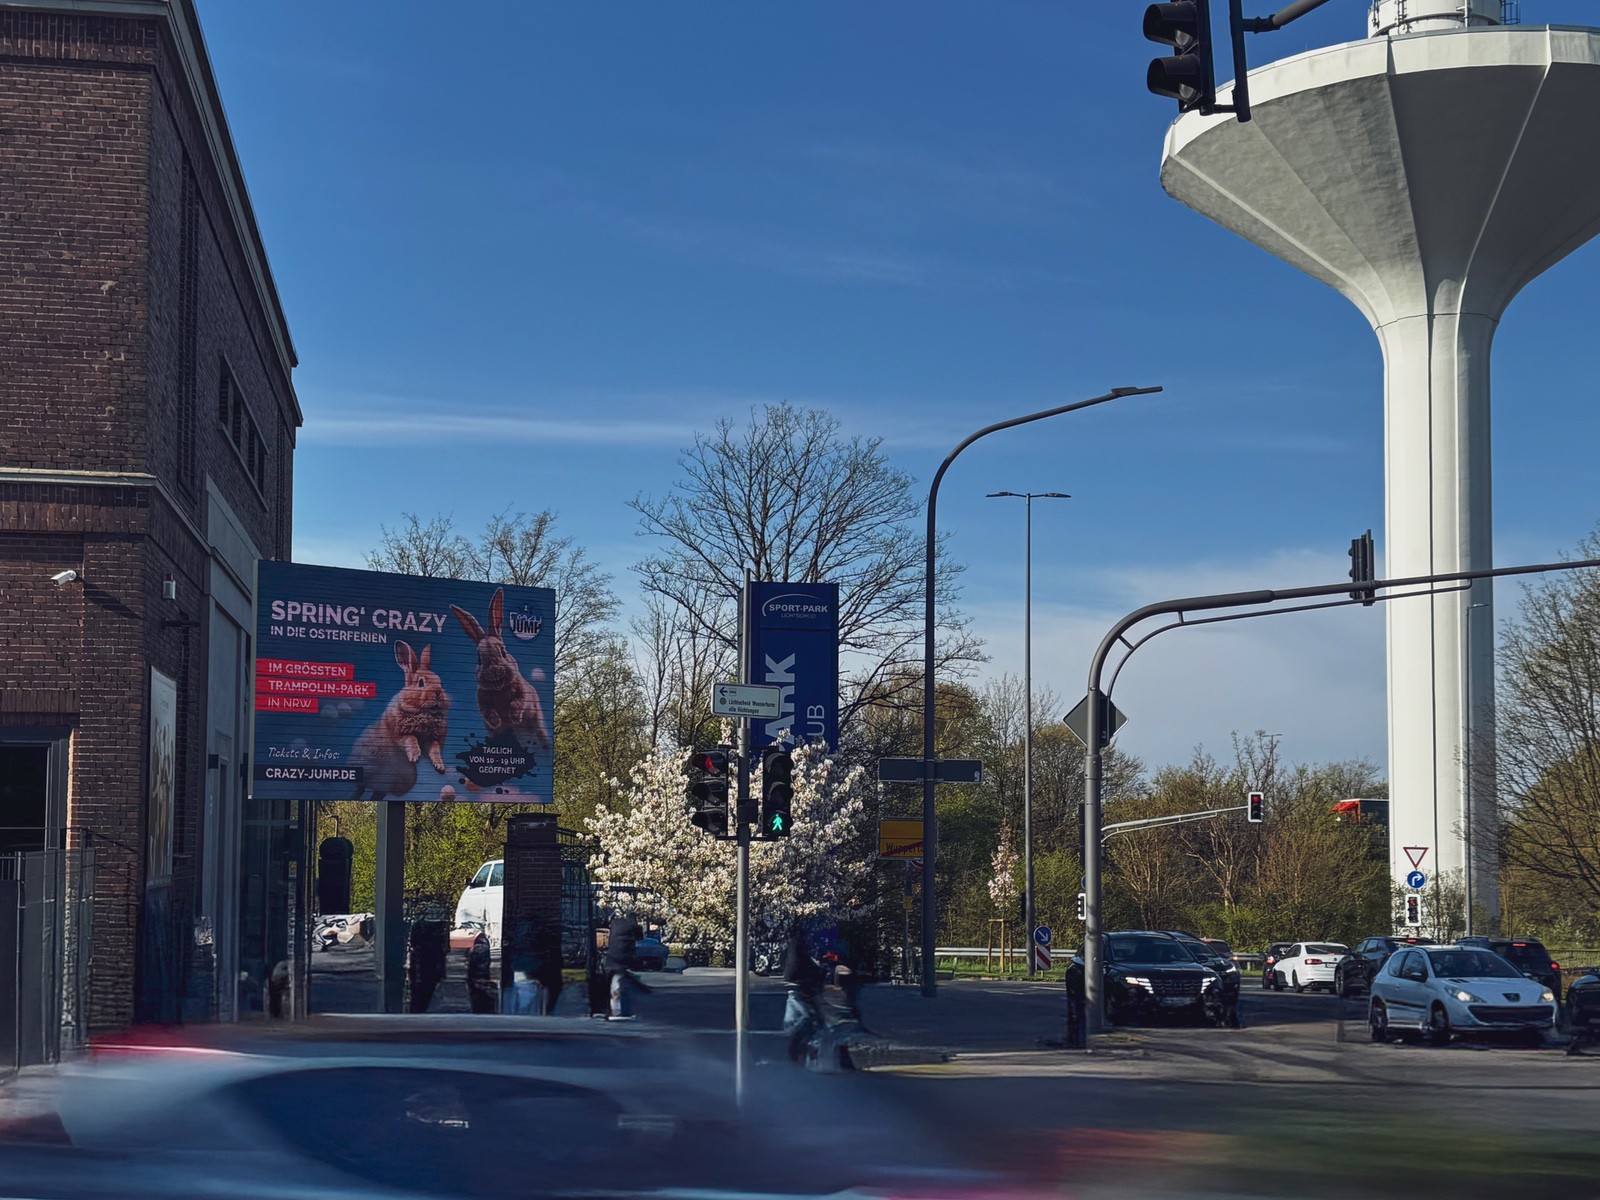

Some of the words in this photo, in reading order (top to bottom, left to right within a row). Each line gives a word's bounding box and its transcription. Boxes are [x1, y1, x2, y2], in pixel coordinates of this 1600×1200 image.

[372, 609, 447, 632] CRAZY
[270, 626, 283, 636] IN
[287, 627, 306, 637] DIE
[309, 628, 387, 644] OSTERFERIEN
[268, 662, 282, 672] IM
[286, 662, 346, 677] GRÖSSTEN
[268, 680, 369, 695] TRAMPOLIN-PARK
[268, 698, 280, 708] IN
[283, 698, 312, 708] NRW
[765, 653, 795, 751] ARK
[268, 747, 299, 759] Tickets
[302, 747, 311, 759] &
[313, 748, 340, 761] Infos:
[469, 756, 485, 764] VON
[501, 758, 509, 766] 19
[510, 757, 526, 765] UHR
[265, 767, 356, 780] CRAZY-JUMP.DE
